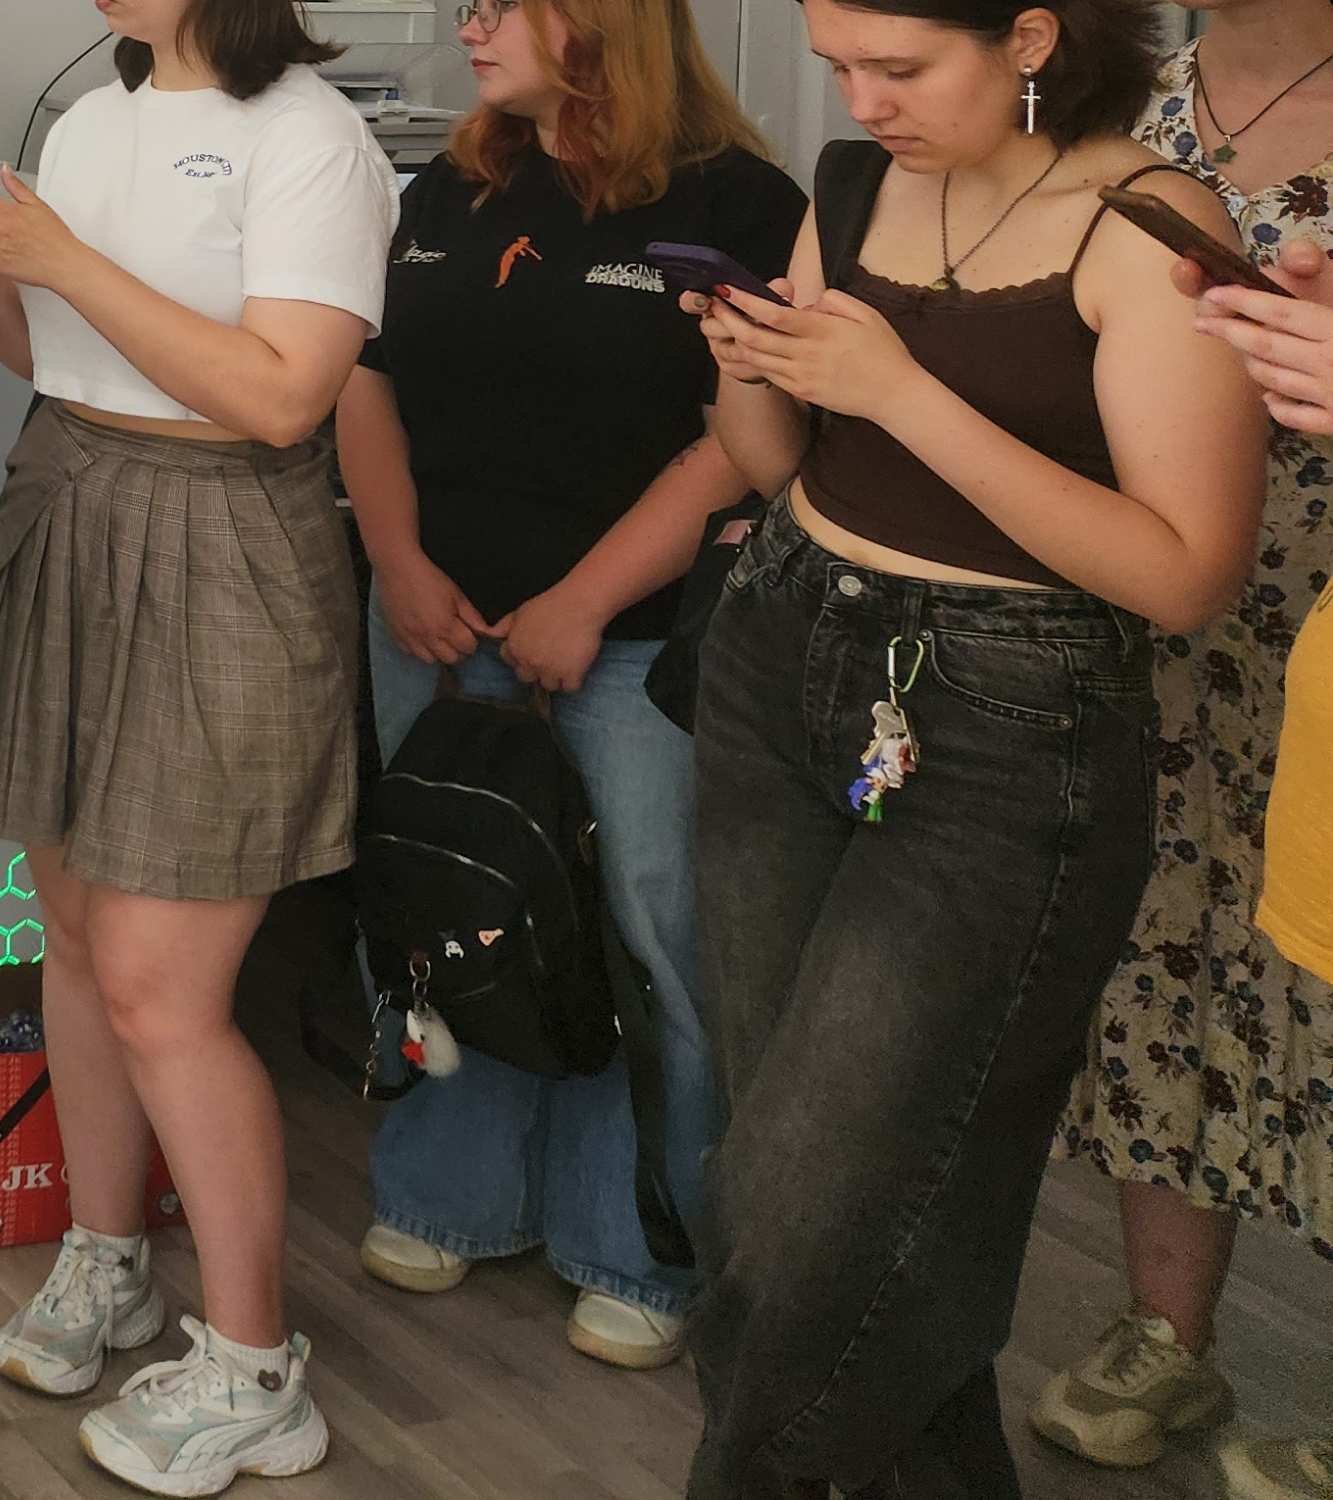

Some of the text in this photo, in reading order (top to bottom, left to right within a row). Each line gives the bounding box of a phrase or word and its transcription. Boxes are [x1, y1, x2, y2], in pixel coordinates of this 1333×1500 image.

[173, 153, 225, 169] HOUSTON
[585, 271, 666, 293] DRAGONS
[590, 263, 664, 281] IMAGINE
[1, 1162, 53, 1191] JK
